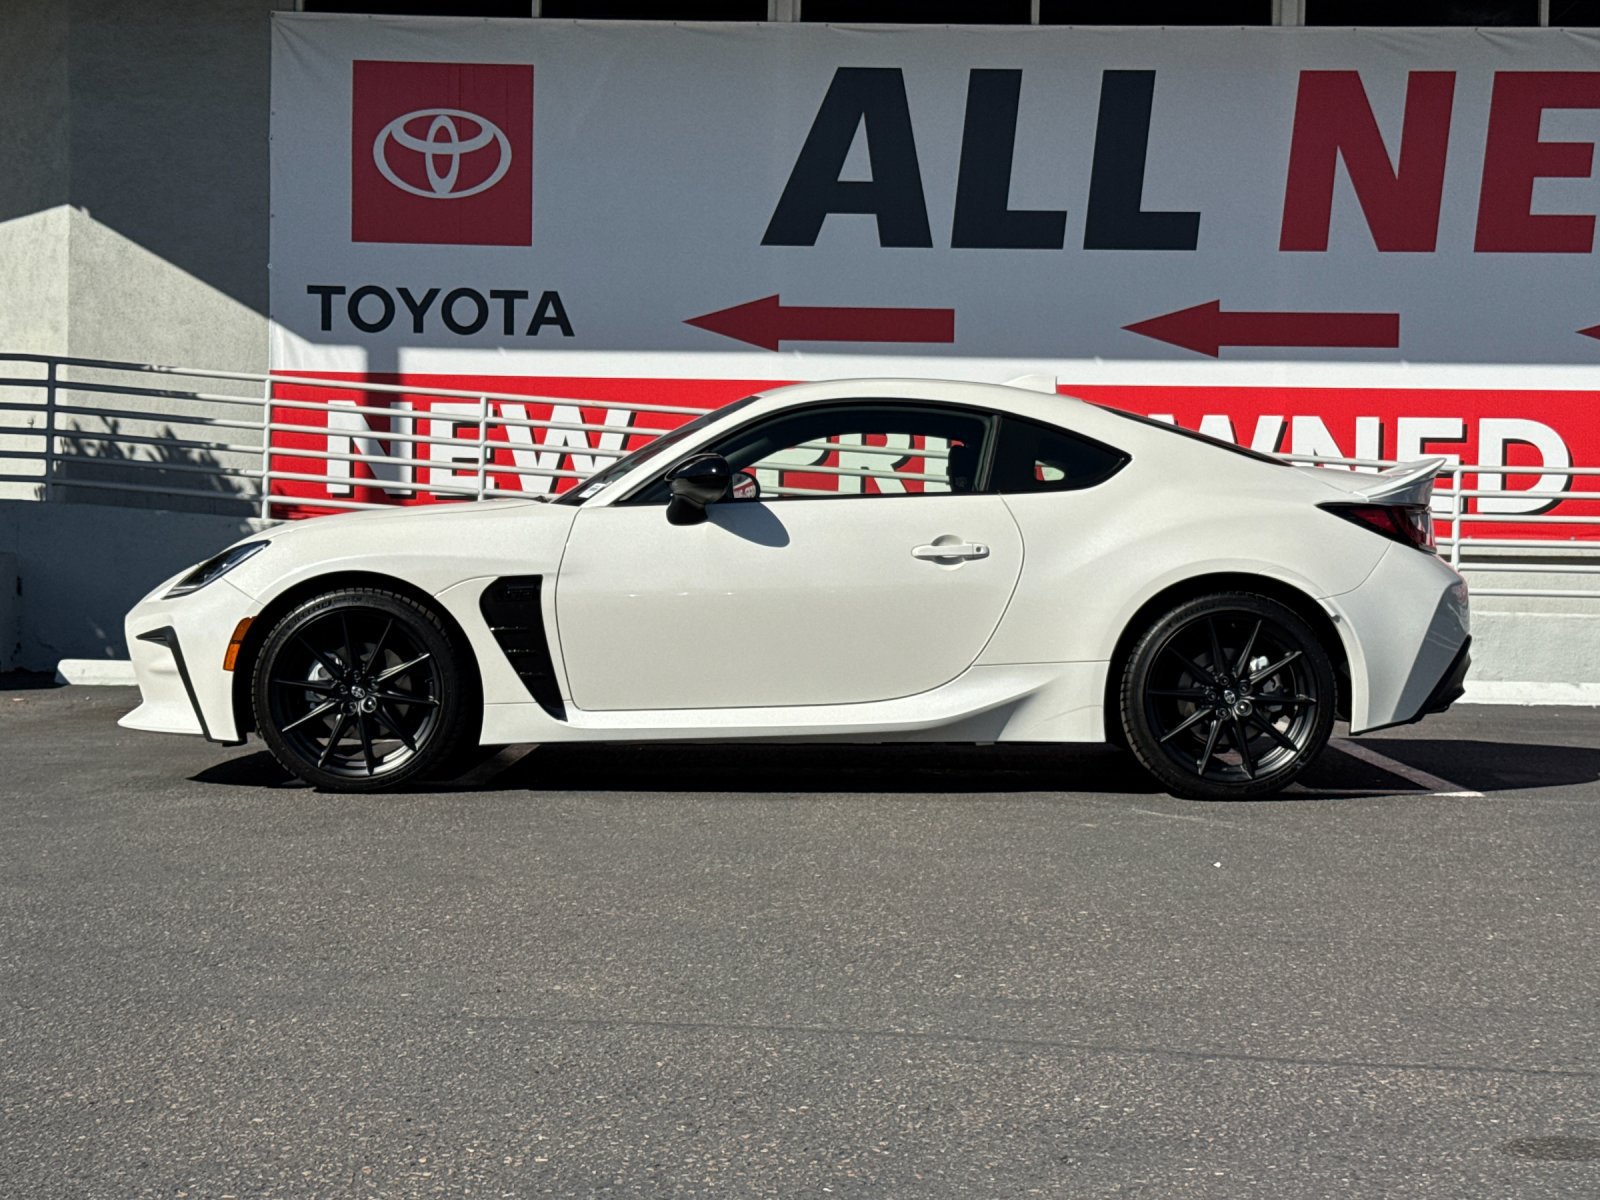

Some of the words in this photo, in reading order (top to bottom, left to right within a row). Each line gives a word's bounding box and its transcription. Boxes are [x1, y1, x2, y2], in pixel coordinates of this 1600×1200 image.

[760, 66, 1201, 251] ALL
[1278, 70, 1600, 254] NE
[306, 284, 576, 337] TOYOTA
[326, 399, 634, 498] NEW
